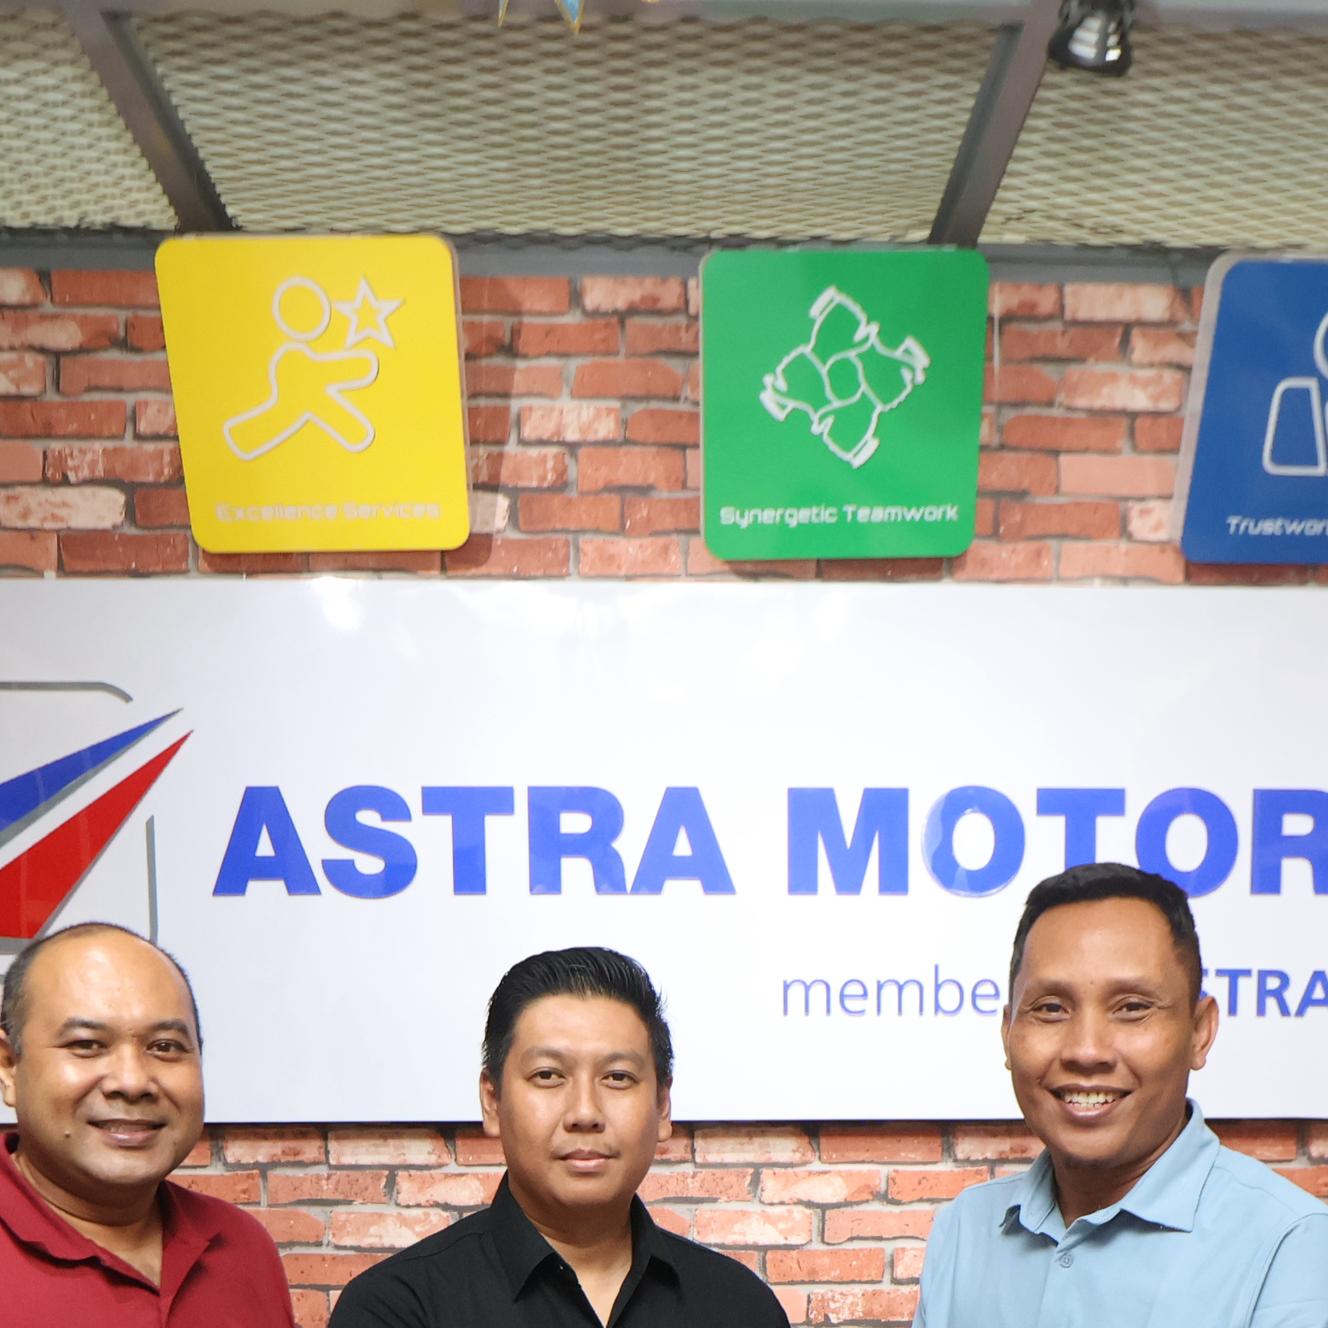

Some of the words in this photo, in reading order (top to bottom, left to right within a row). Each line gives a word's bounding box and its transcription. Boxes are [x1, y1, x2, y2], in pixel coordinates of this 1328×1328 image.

[215, 501, 339, 522] Excellence
[343, 500, 442, 520] Services
[719, 504, 838, 528] Synergetic
[842, 503, 959, 523] Teamwork
[213, 784, 736, 900] ASTRA
[782, 963, 1001, 1017] membe
